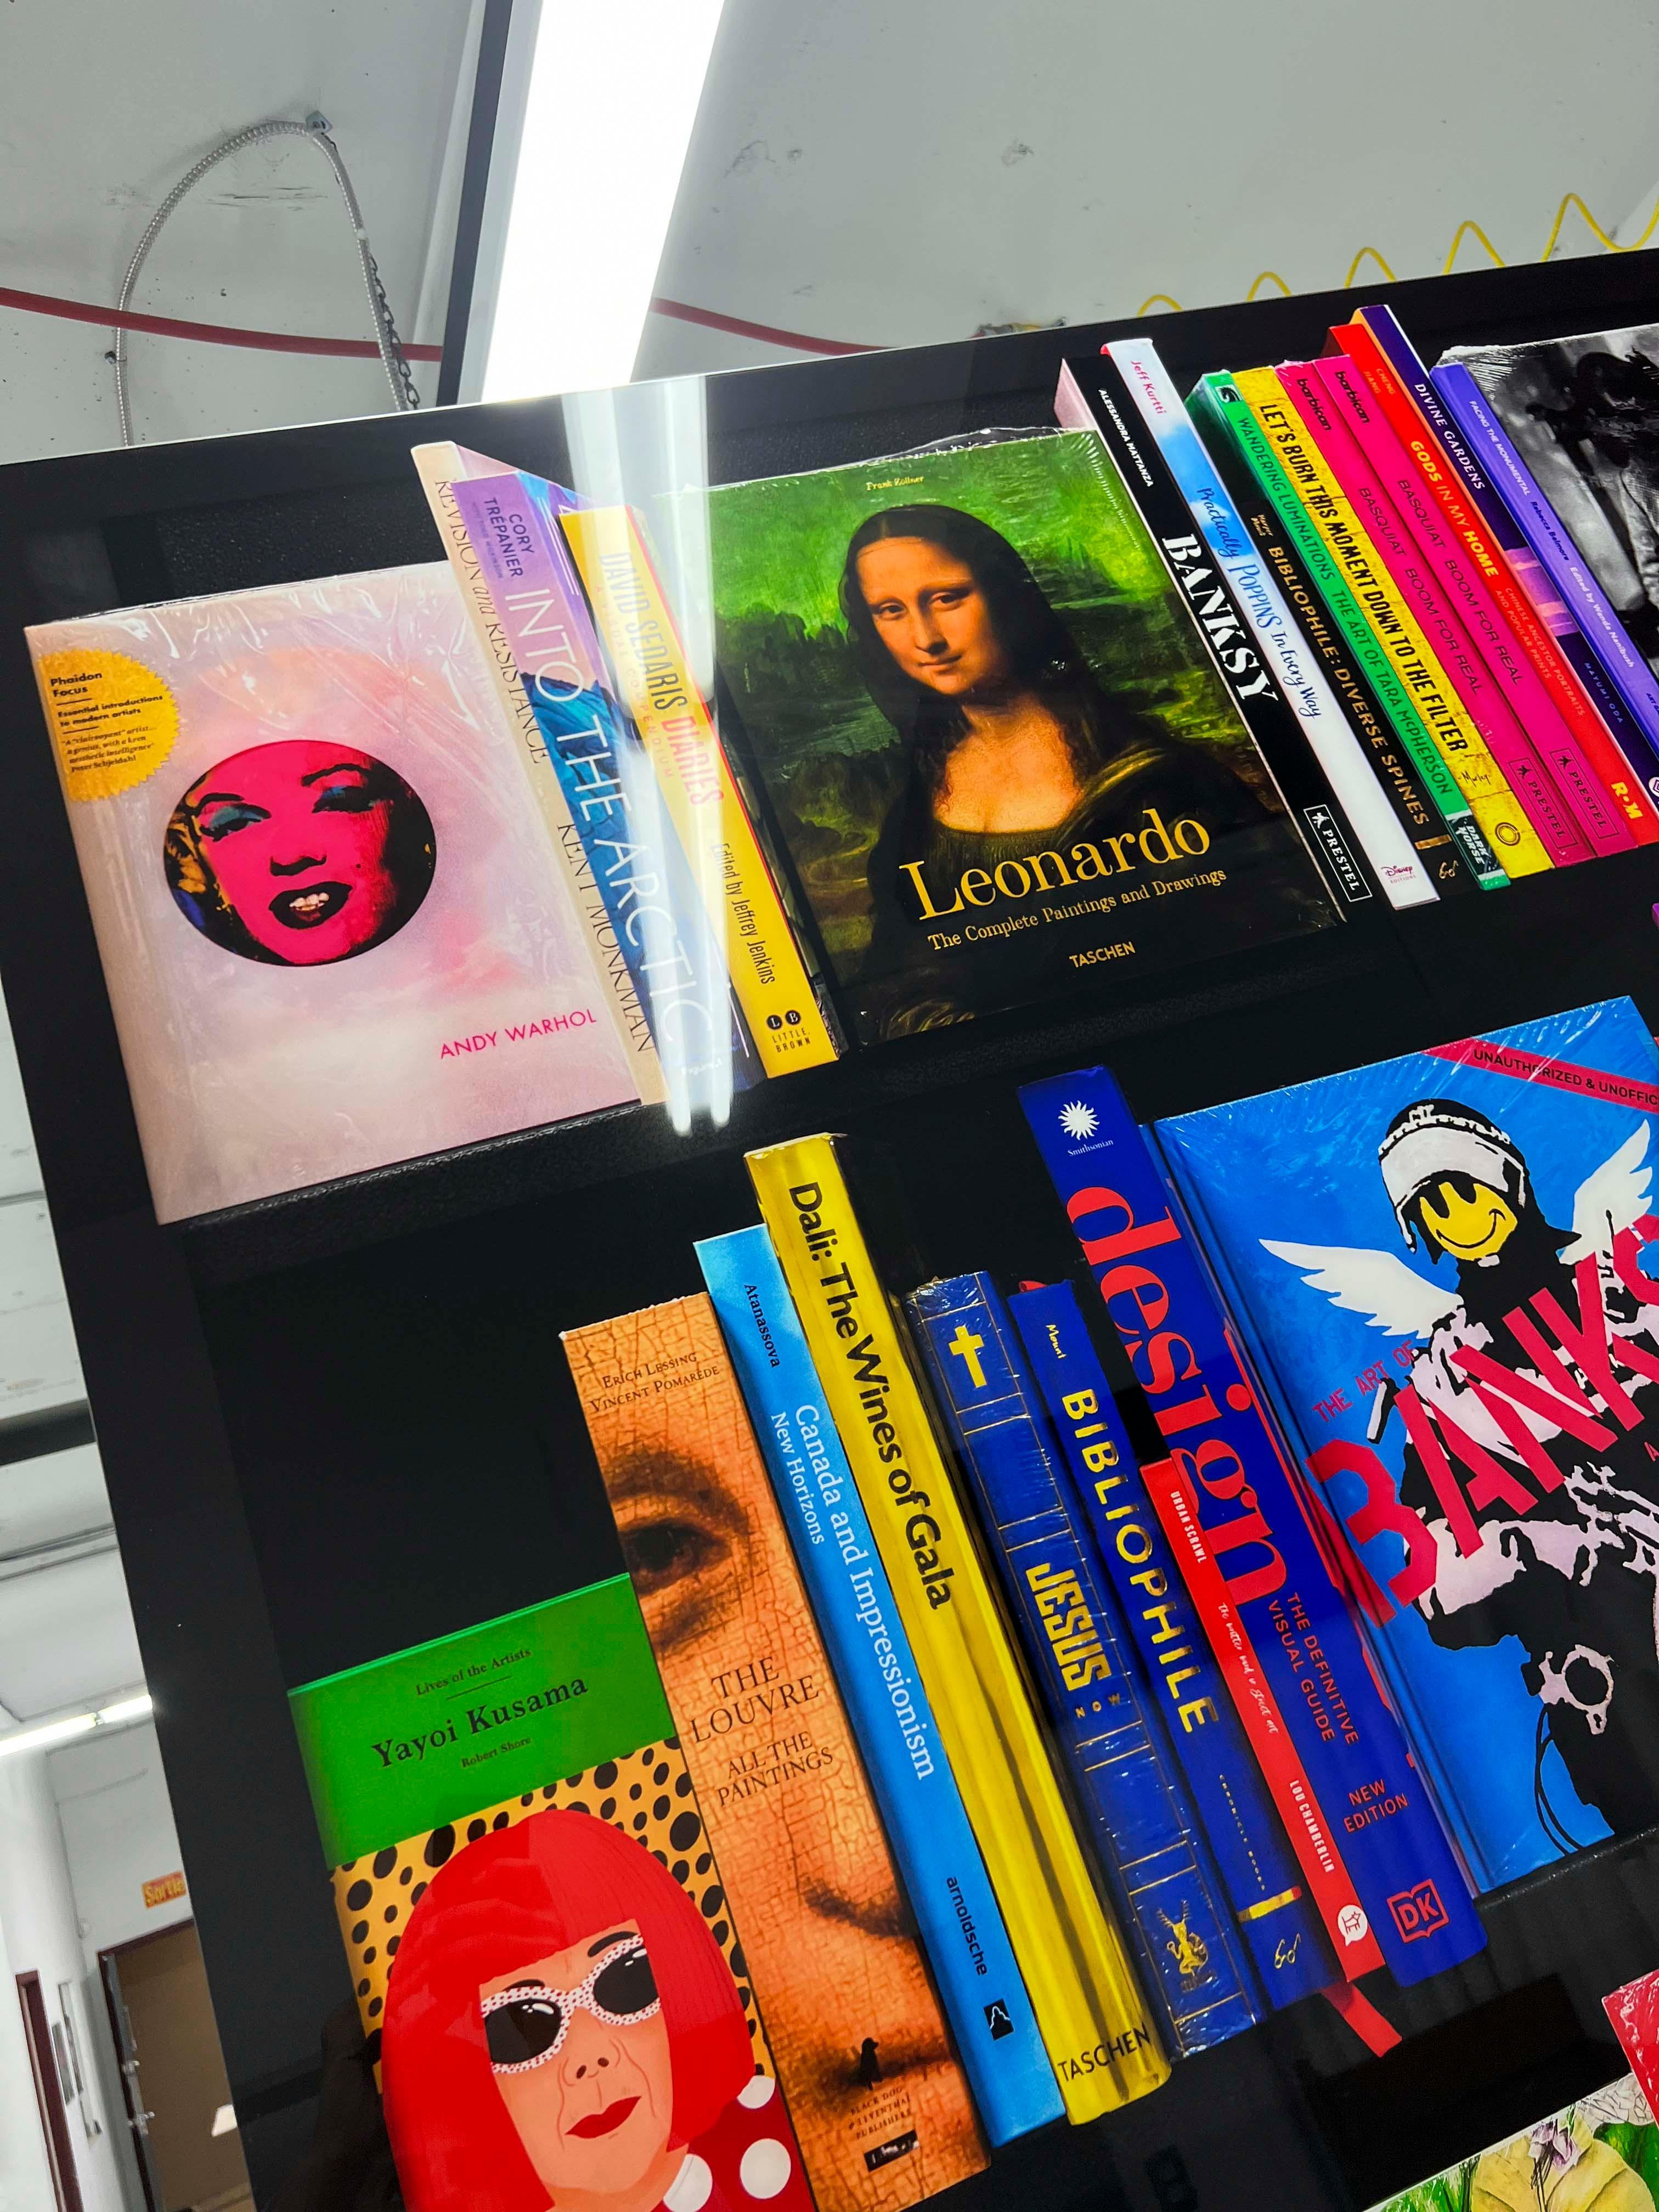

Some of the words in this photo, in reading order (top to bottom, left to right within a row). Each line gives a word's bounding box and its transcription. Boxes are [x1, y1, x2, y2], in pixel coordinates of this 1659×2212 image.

[1131, 360, 1149, 381] Jeff
[1143, 383, 1167, 415] Kurtti
[1296, 377, 1332, 432] barbican
[1334, 370, 1370, 425] barbican
[1375, 368, 1396, 396] CHENG
[1098, 389, 1132, 443] ALESSANDRA
[1126, 442, 1154, 487] MATTANZA
[1282, 445, 1320, 484] BURN
[1414, 383, 1449, 427] DIVINE
[1443, 431, 1486, 490] GARDENS
[1306, 484, 1339, 520] THIS
[1410, 440, 1443, 483] GODS
[1436, 484, 1454, 502] IN
[1447, 505, 1471, 527] MY
[1463, 530, 1499, 578] HOME
[1469, 400, 1489, 427] FACING
[1486, 428, 1500, 444] THE
[1495, 443, 1532, 496] MONUMENTAL
[1530, 501, 1550, 531] Rebecca
[1549, 532, 1569, 561] Belmore
[1570, 567, 1589, 592] Edited
[1585, 593, 1595, 603] by
[1593, 604, 1612, 635] Wanda
[509, 514, 534, 554] CORY
[1237, 416, 1286, 492] WANDERING
[1277, 493, 1335, 581] LUMINATIONS
[1331, 589, 1356, 617] THE
[1348, 620, 1371, 645] ART
[1363, 650, 1383, 667] OF
[1375, 671, 1400, 707] TARA
[1324, 521, 1379, 588] MOMENT
[1196, 487, 1244, 560] Practically
[1271, 631, 1288, 648] In
[1281, 650, 1307, 687] Every
[1299, 687, 1321, 720] Way
[1358, 487, 1407, 557] BASQUIAT
[1404, 568, 1441, 616] BOOM
[1434, 619, 1460, 651] FOR
[1455, 654, 1483, 696] REAL
[1397, 479, 1447, 549] BASQUIAT
[1443, 559, 1479, 607] BOOM
[1474, 610, 1500, 643] FOR
[1494, 645, 1523, 683] REAL
[1161, 533, 1278, 701] BANKSY
[1363, 590, 1404, 635] DOWN
[1495, 590, 1510, 609] AND
[1506, 609, 1532, 648] POPULAR
[1529, 648, 1553, 680] PRINTS
[505, 589, 584, 702] INTO
[1390, 635, 1417, 658] TO
[1402, 658, 1436, 693] THE
[1505, 588, 1530, 623] CHINESE
[1527, 623, 1557, 669] ANCESTOR
[1553, 668, 1586, 716] PORTRAITS
[50, 672, 103, 686] Phaidon
[53, 685, 88, 697] Focus
[58, 705, 99, 718] Essential
[101, 695, 163, 710] introductions
[599, 552, 650, 613] DAVID
[625, 620, 689, 710] SEDARIS
[661, 715, 725, 806] DIARIES
[1268, 546, 1341, 665] BIBLIOPHILE:
[1334, 668, 1389, 749] DIVERSE
[1381, 754, 1430, 825] SPINES
[1584, 663, 1610, 699] MAYUMI
[1609, 703, 1623, 723] ODA
[73, 714, 109, 725] modern
[112, 708, 141, 719] artists
[1421, 693, 1469, 752] FILTER
[556, 714, 633, 822] THE
[472, 585, 498, 616] and
[586, 905, 655, 1052] MONKMAN
[1527, 780, 1567, 839] PRESTEL
[1568, 771, 1609, 830] PRESTEL
[710, 843, 734, 879] Edited
[899, 808, 1210, 921] Leonardo
[1323, 828, 1361, 891] PRESTEL
[1455, 826, 1485, 865] HORSE
[1466, 825, 1489, 856] DARK
[727, 882, 742, 895] by
[1381, 865, 1413, 877] Disney
[732, 898, 758, 937] Jeffrey
[928, 931, 962, 951] The
[964, 913, 1039, 942] Complete
[1042, 893, 1117, 923] Paintings
[1121, 883, 1149, 904] and
[1152, 868, 1227, 897] Drawings
[593, 839, 712, 1042] ARCTIC
[747, 940, 776, 985] Jenkins
[1069, 941, 1136, 968] TASCHEN
[440, 1031, 496, 1059] ANDY
[505, 1009, 596, 1041] WARHOL
[776, 1036, 811, 1053] BROWN
[1474, 1048, 1583, 1086] UNAUTHORIZED
[1585, 1078, 1595, 1090] &
[1599, 1081, 1659, 1106] UNOFFIC
[1068, 1139, 1114, 1157] Smithsonian
[744, 1283, 780, 1369] Atanassova
[820, 1262, 860, 1339] The
[602, 1369, 642, 1389] ERICH
[645, 1352, 697, 1375] LESSING
[1045, 1324, 1066, 1359] Mount
[589, 1386, 650, 1413] VINCENT
[846, 1333, 902, 1464] Wines
[1066, 1186, 1287, 1605] design
[1312, 1389, 1353, 1423] THE
[1354, 1360, 1391, 1396] ART
[1392, 1339, 1415, 1369] OF
[771, 1411, 795, 1455] New
[786, 1457, 825, 1546] Horizons
[795, 1403, 844, 1509] Canada
[888, 1468, 931, 1508] of
[830, 1511, 870, 1566] and
[1170, 1491, 1192, 1523] URBAN
[1184, 1525, 1207, 1564] SCRAWL
[905, 1513, 955, 1611] Gala
[1062, 1389, 1219, 1733] BIBLIOPHILE
[1026, 1562, 1112, 1691] JESUS
[415, 1678, 449, 1696] Lives
[452, 1669, 465, 1683] of
[467, 1662, 487, 1677] the
[490, 1647, 531, 1669] Artists
[710, 1656, 779, 1699] THE
[849, 1566, 935, 1781] Impressionism
[1268, 1599, 1305, 1674] VISUAL
[1300, 1678, 1336, 1742] GUIDE
[1286, 1592, 1312, 1632] THE
[1304, 1634, 1359, 1745] DEFINITIVE
[371, 1719, 459, 1768] Yayoi
[466, 1678, 588, 1735] Kusama
[690, 1675, 820, 1743] LOUVRE
[461, 1748, 498, 1768] Robert
[500, 1736, 531, 1753] Shore
[716, 1747, 833, 1807] PAINTINGS
[728, 1751, 766, 1779] ALL
[767, 1731, 814, 1760] THE
[1343, 1793, 1409, 1833] EDITION
[1347, 1778, 1386, 1807] NEW
[1289, 1780, 1307, 1802] LOU
[1298, 1802, 1335, 1873] CHAMBERLIN
[946, 1876, 988, 1976] arnoldsche
[1057, 2022, 1152, 2083] TASCHEN
